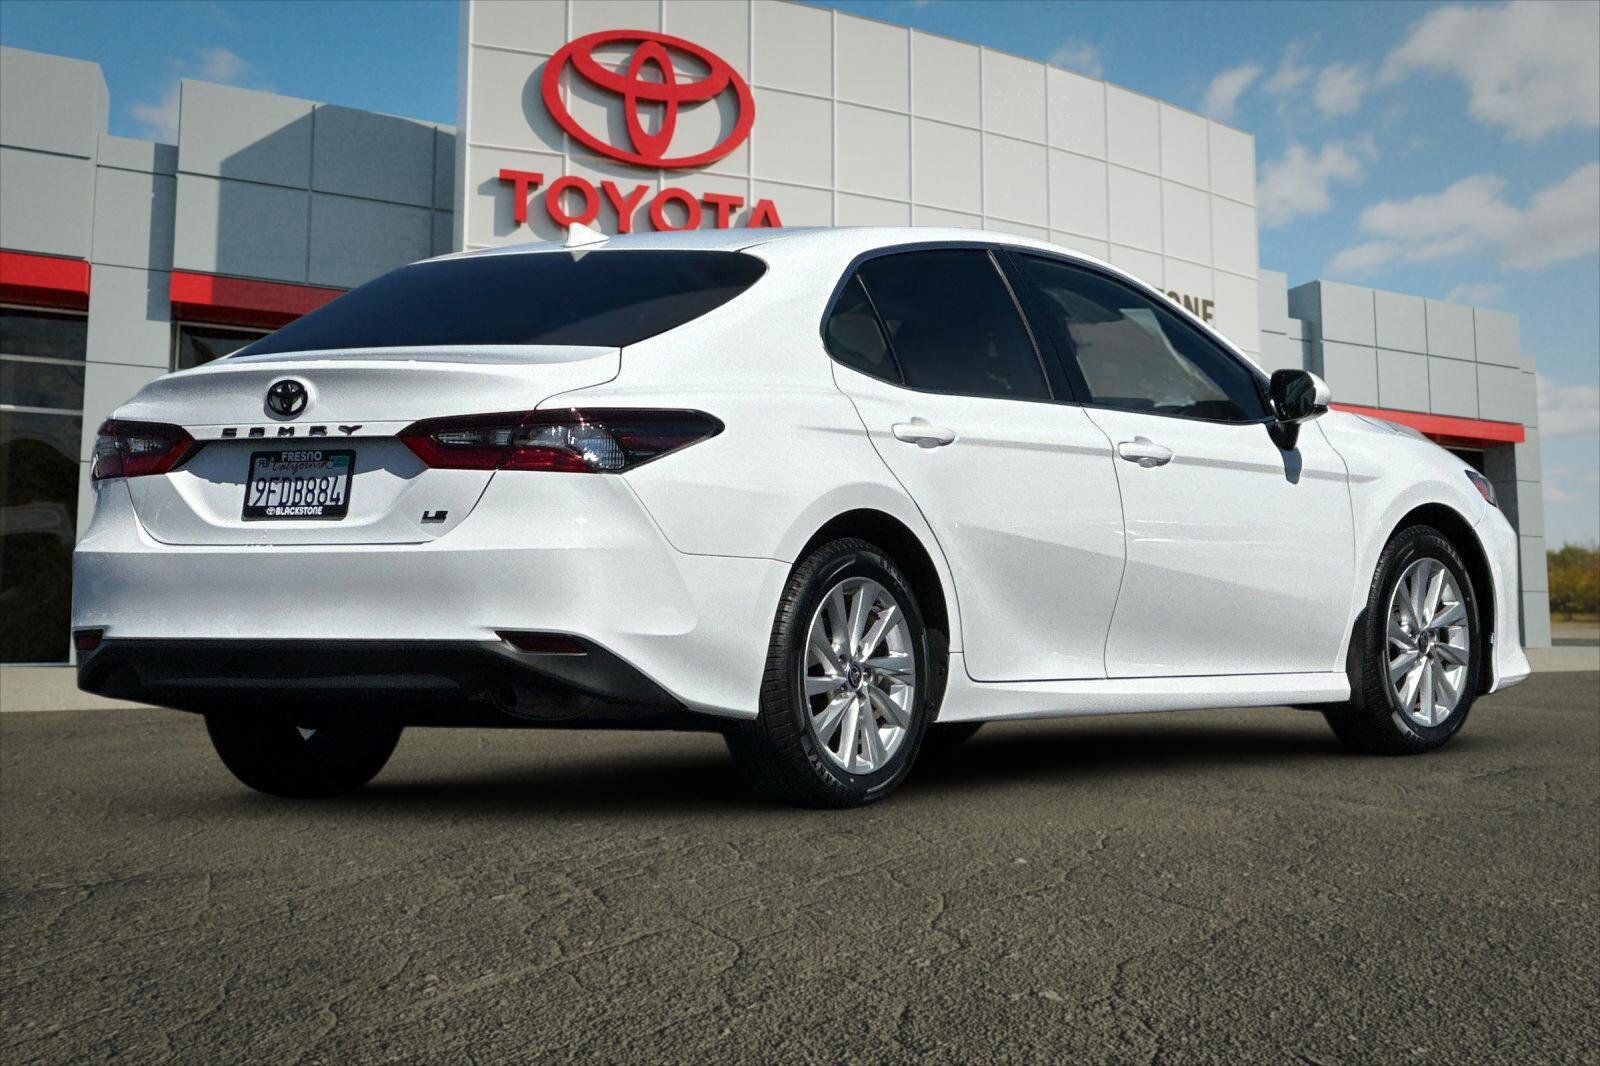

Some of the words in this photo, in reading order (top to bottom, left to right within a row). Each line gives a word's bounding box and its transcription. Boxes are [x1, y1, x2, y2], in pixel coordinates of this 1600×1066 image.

[499, 168, 783, 233] TOYOTA
[281, 451, 323, 462] FRESNO
[254, 476, 341, 506] 9FDB884
[275, 506, 323, 516] BLACKSTONE
